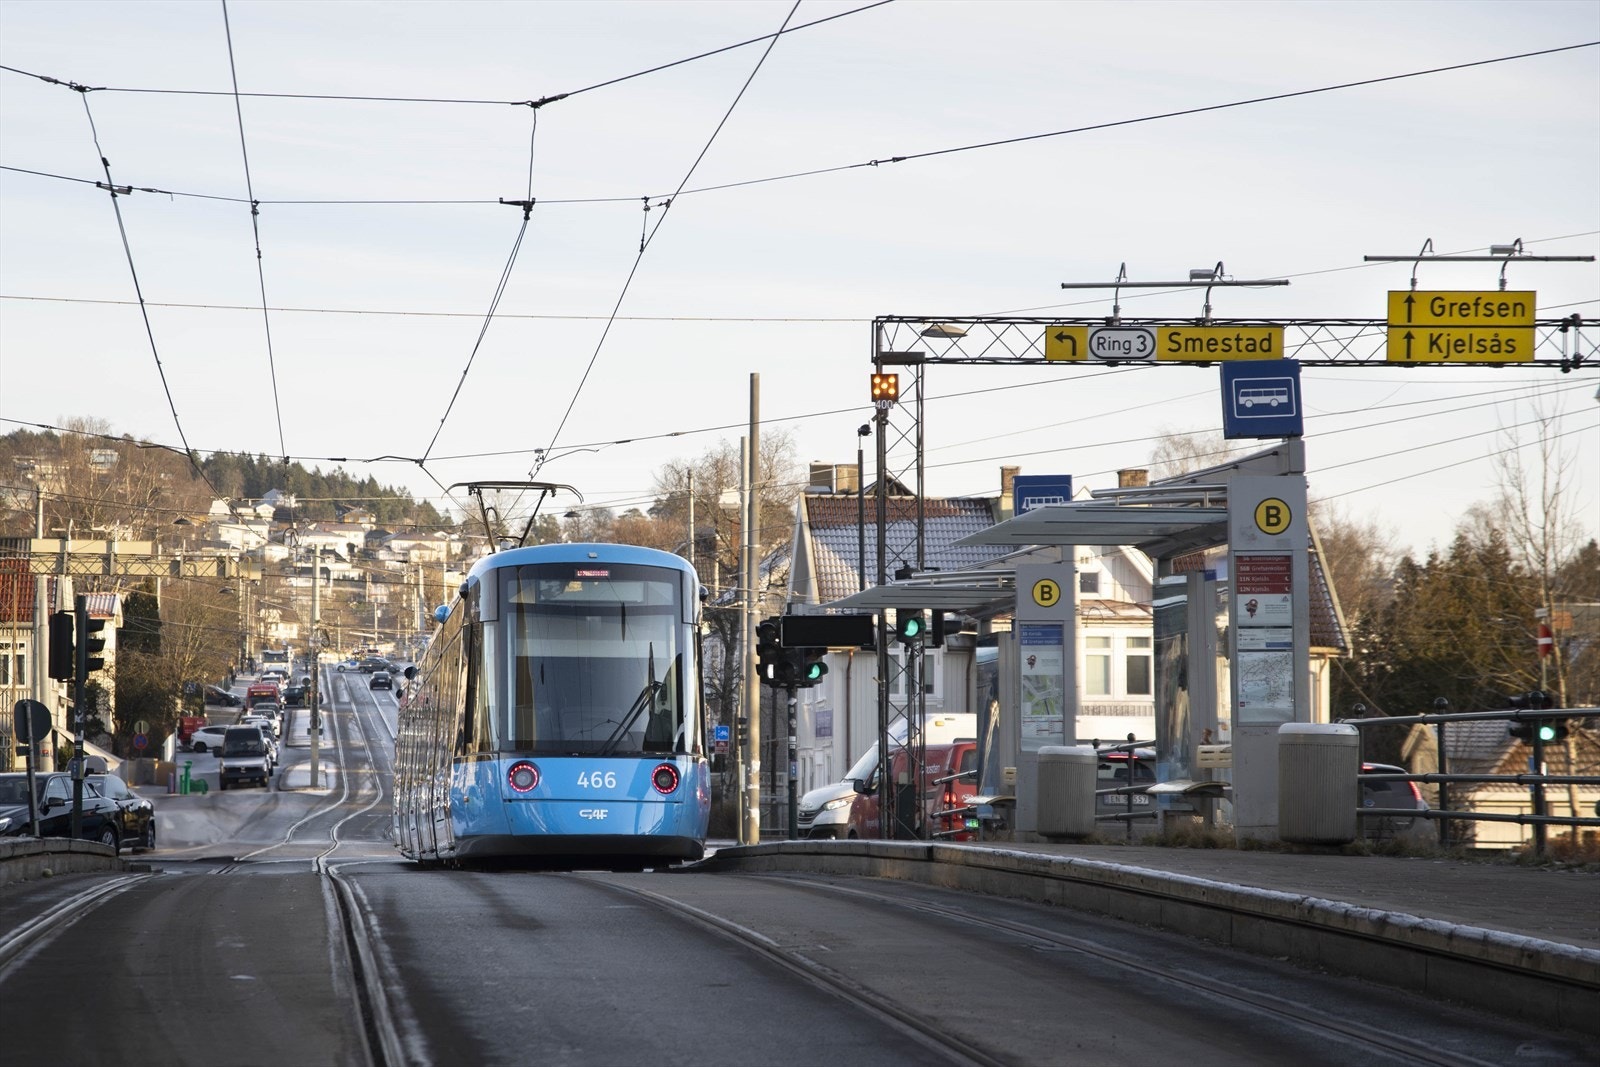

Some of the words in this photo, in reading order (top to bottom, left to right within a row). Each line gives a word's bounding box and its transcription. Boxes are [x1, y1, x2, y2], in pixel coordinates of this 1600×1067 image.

[1429, 296, 1526, 318] Grefsen
[1095, 335, 1132, 355] Ring
[1135, 334, 1149, 353] 3
[1167, 332, 1273, 354] Smestad
[1428, 333, 1517, 359] Kjelsås
[875, 399, 893, 409] 400
[1265, 505, 1282, 527] B
[1040, 584, 1053, 602] B
[576, 771, 617, 789] 466
